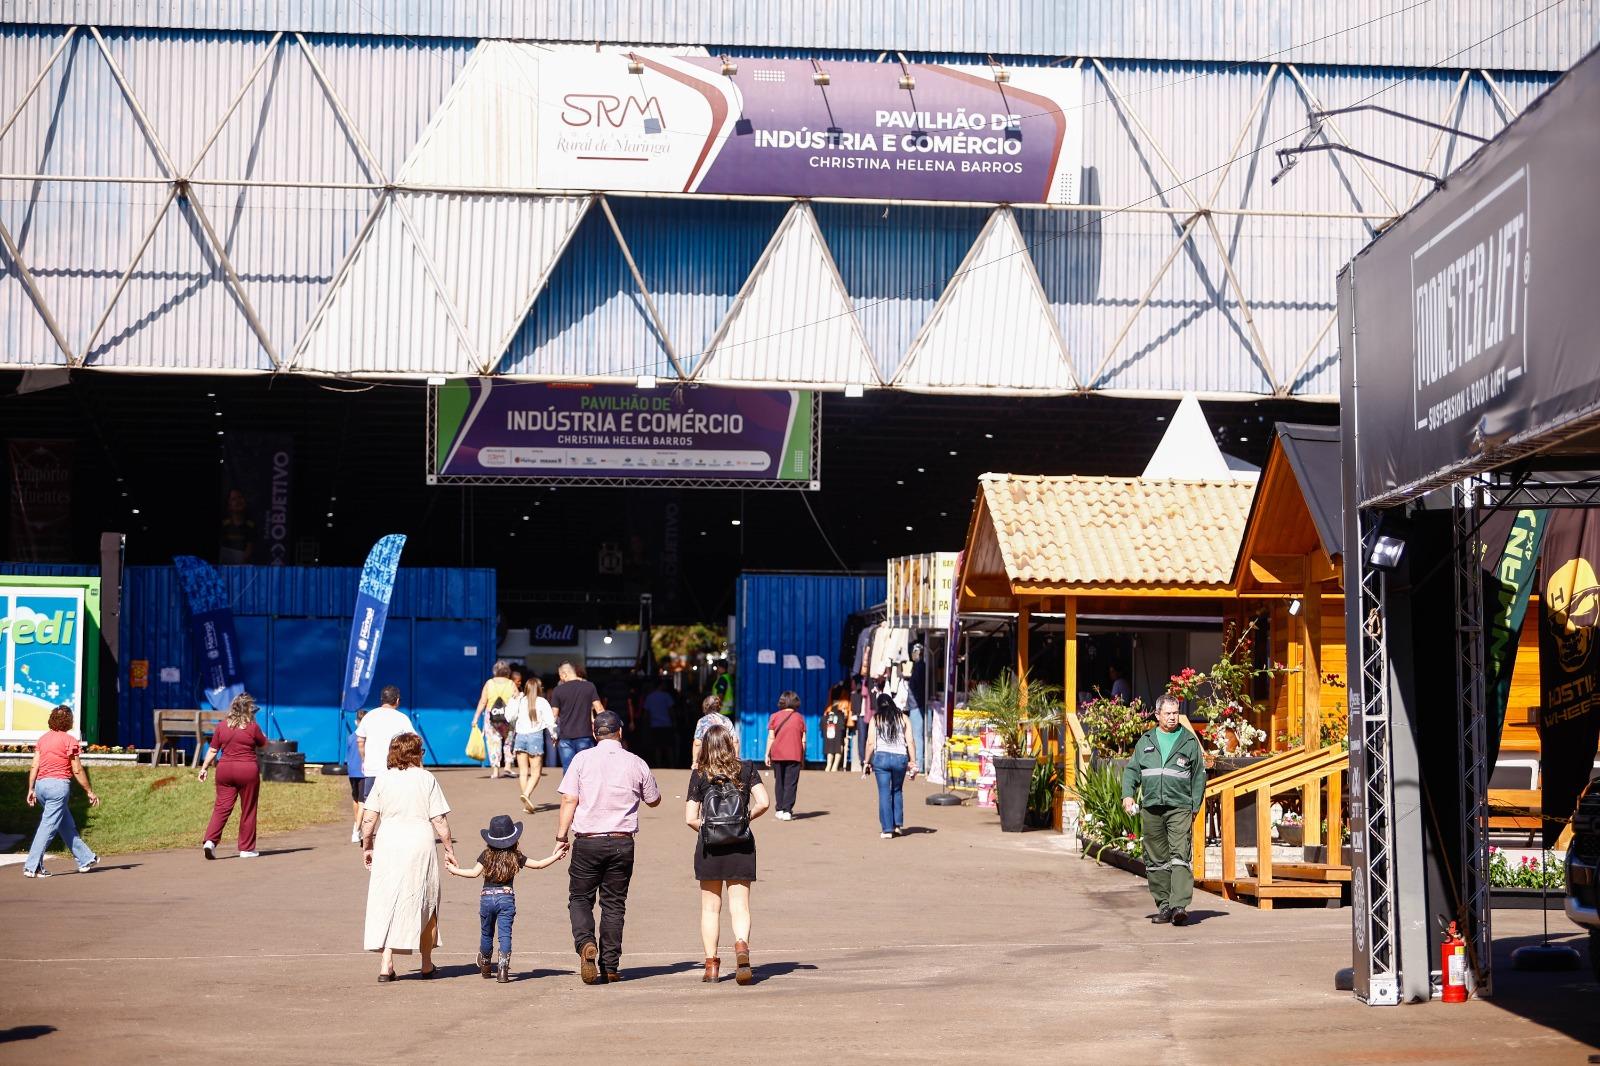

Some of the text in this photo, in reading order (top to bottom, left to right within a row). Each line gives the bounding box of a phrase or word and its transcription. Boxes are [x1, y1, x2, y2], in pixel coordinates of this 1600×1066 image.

[561, 94, 666, 129] SRM
[875, 109, 1022, 133] PAVILHÃO DE
[754, 126, 1022, 156] INDÚSTRIA E COMÉRCIO
[809, 155, 1023, 174] CHRISTINA HELENA BARROS
[580, 395, 671, 411] PAVILHÃO DE
[1428, 391, 1466, 432] SUSPENSION
[1471, 381, 1489, 409] BODY
[1489, 365, 1506, 399] LIFT
[507, 406, 744, 434] INDÚSTRIA E COMÉRCIO
[557, 435, 693, 447] CHRISTINA HELENA BARROS
[271, 451, 290, 540] OBJETIVO
[535, 623, 574, 641] Bull
